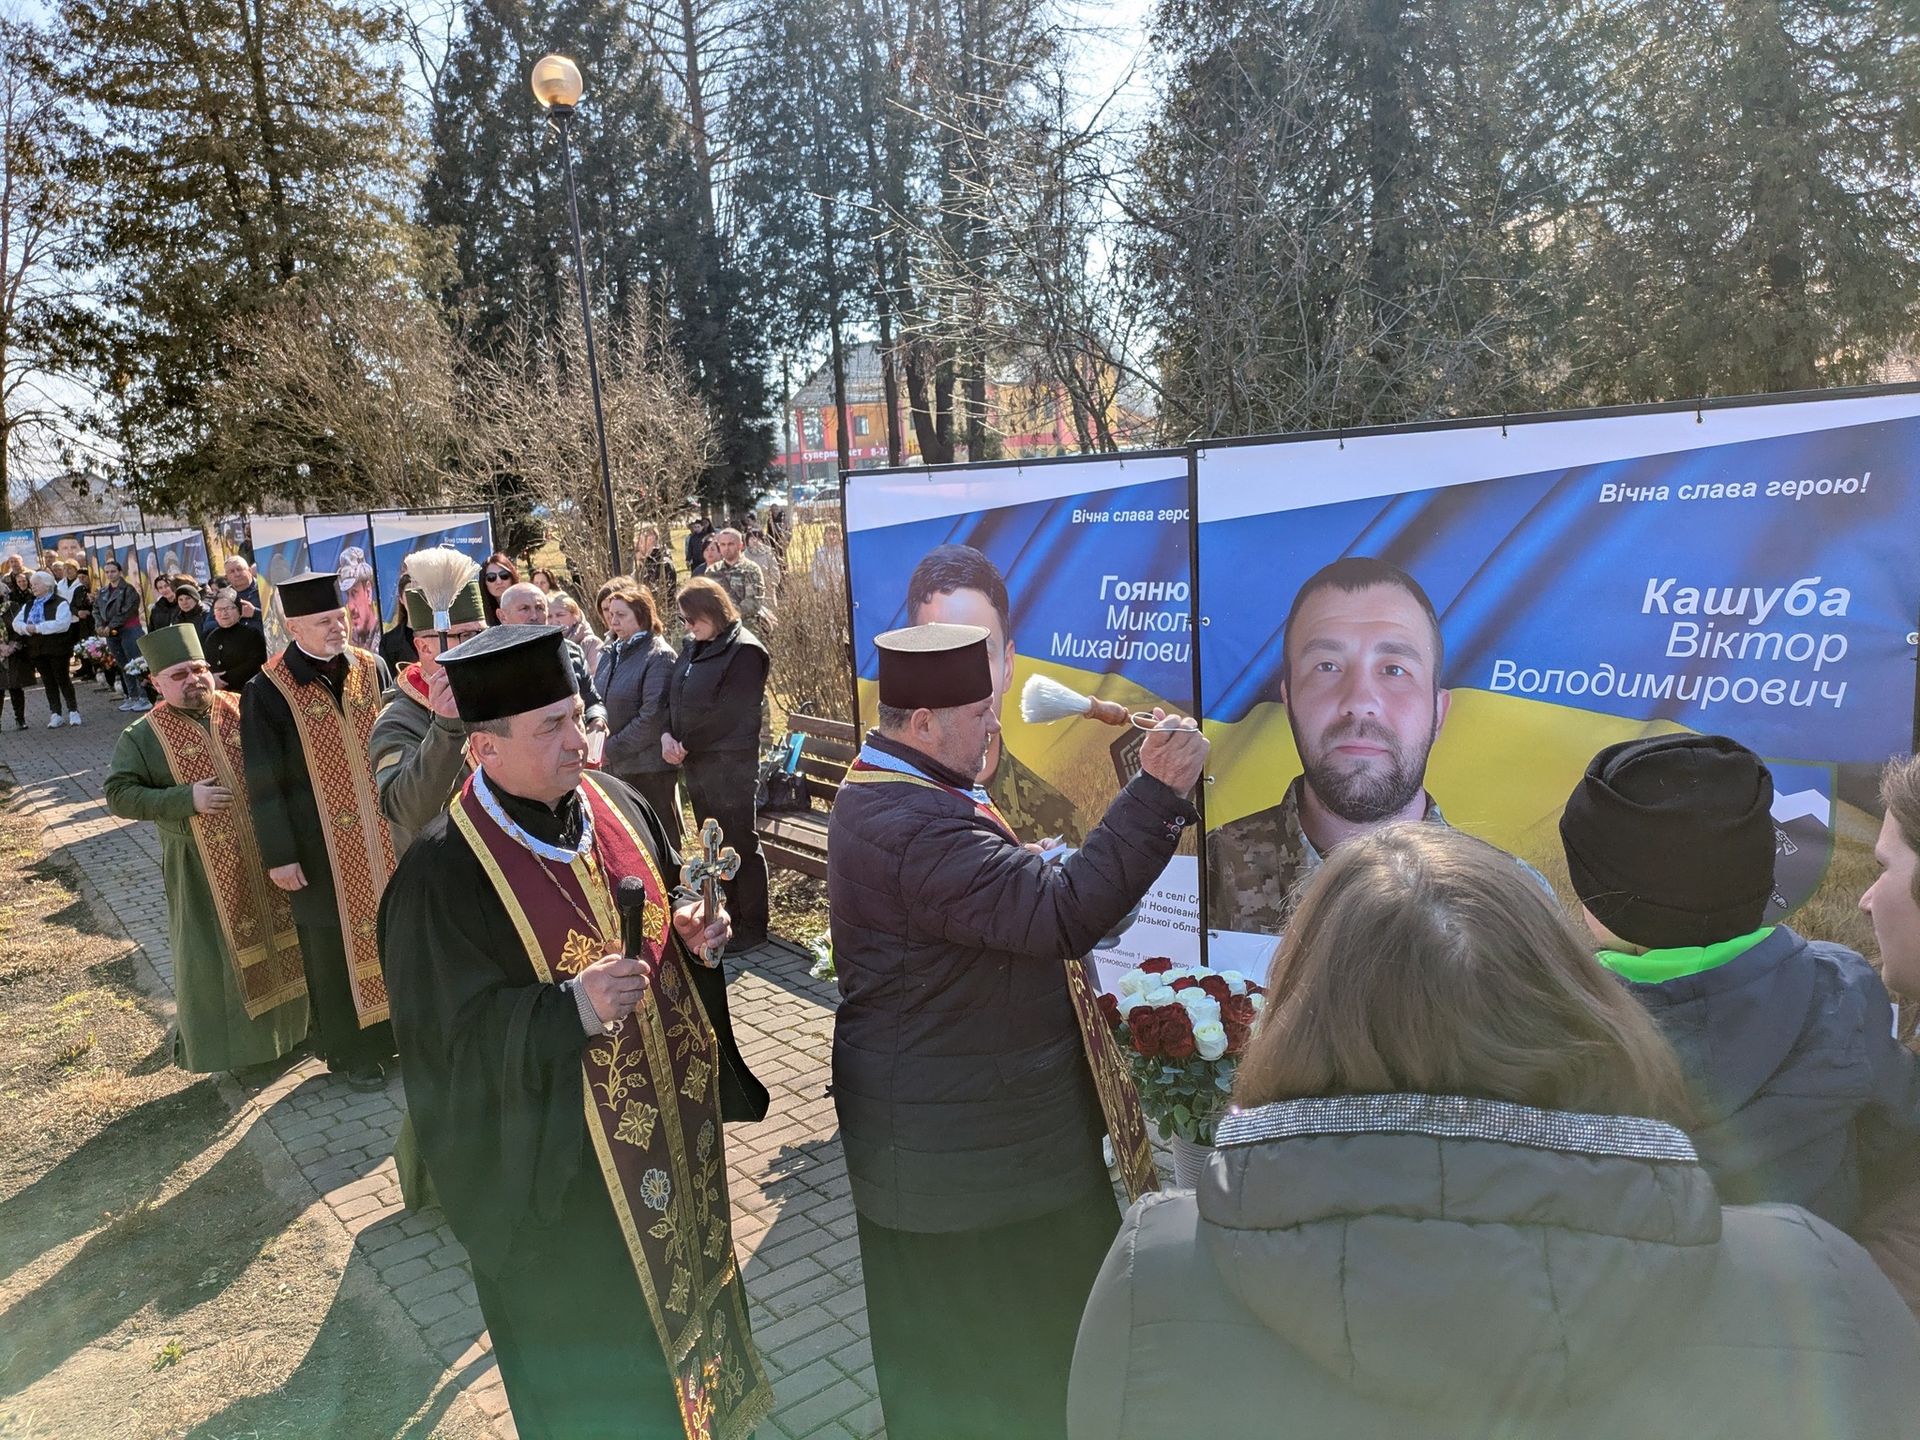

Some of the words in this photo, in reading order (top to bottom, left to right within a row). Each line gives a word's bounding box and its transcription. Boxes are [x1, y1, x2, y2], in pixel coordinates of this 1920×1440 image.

[803, 447, 862, 461] супермет
[1599, 483, 1670, 503] Вічна
[1677, 481, 1758, 500] слава
[1765, 472, 1871, 501] герою!
[1072, 509, 1109, 523] Вічна
[1113, 509, 1154, 522] слава
[1099, 575, 1190, 601] Гояню
[1641, 576, 1851, 626] Кашуба
[1106, 604, 1192, 632] Микол
[1051, 632, 1192, 663] Михайлови
[1665, 621, 1848, 672] Віктор
[1488, 659, 1848, 710] Володимирович
[1166, 892, 1186, 902] селі
